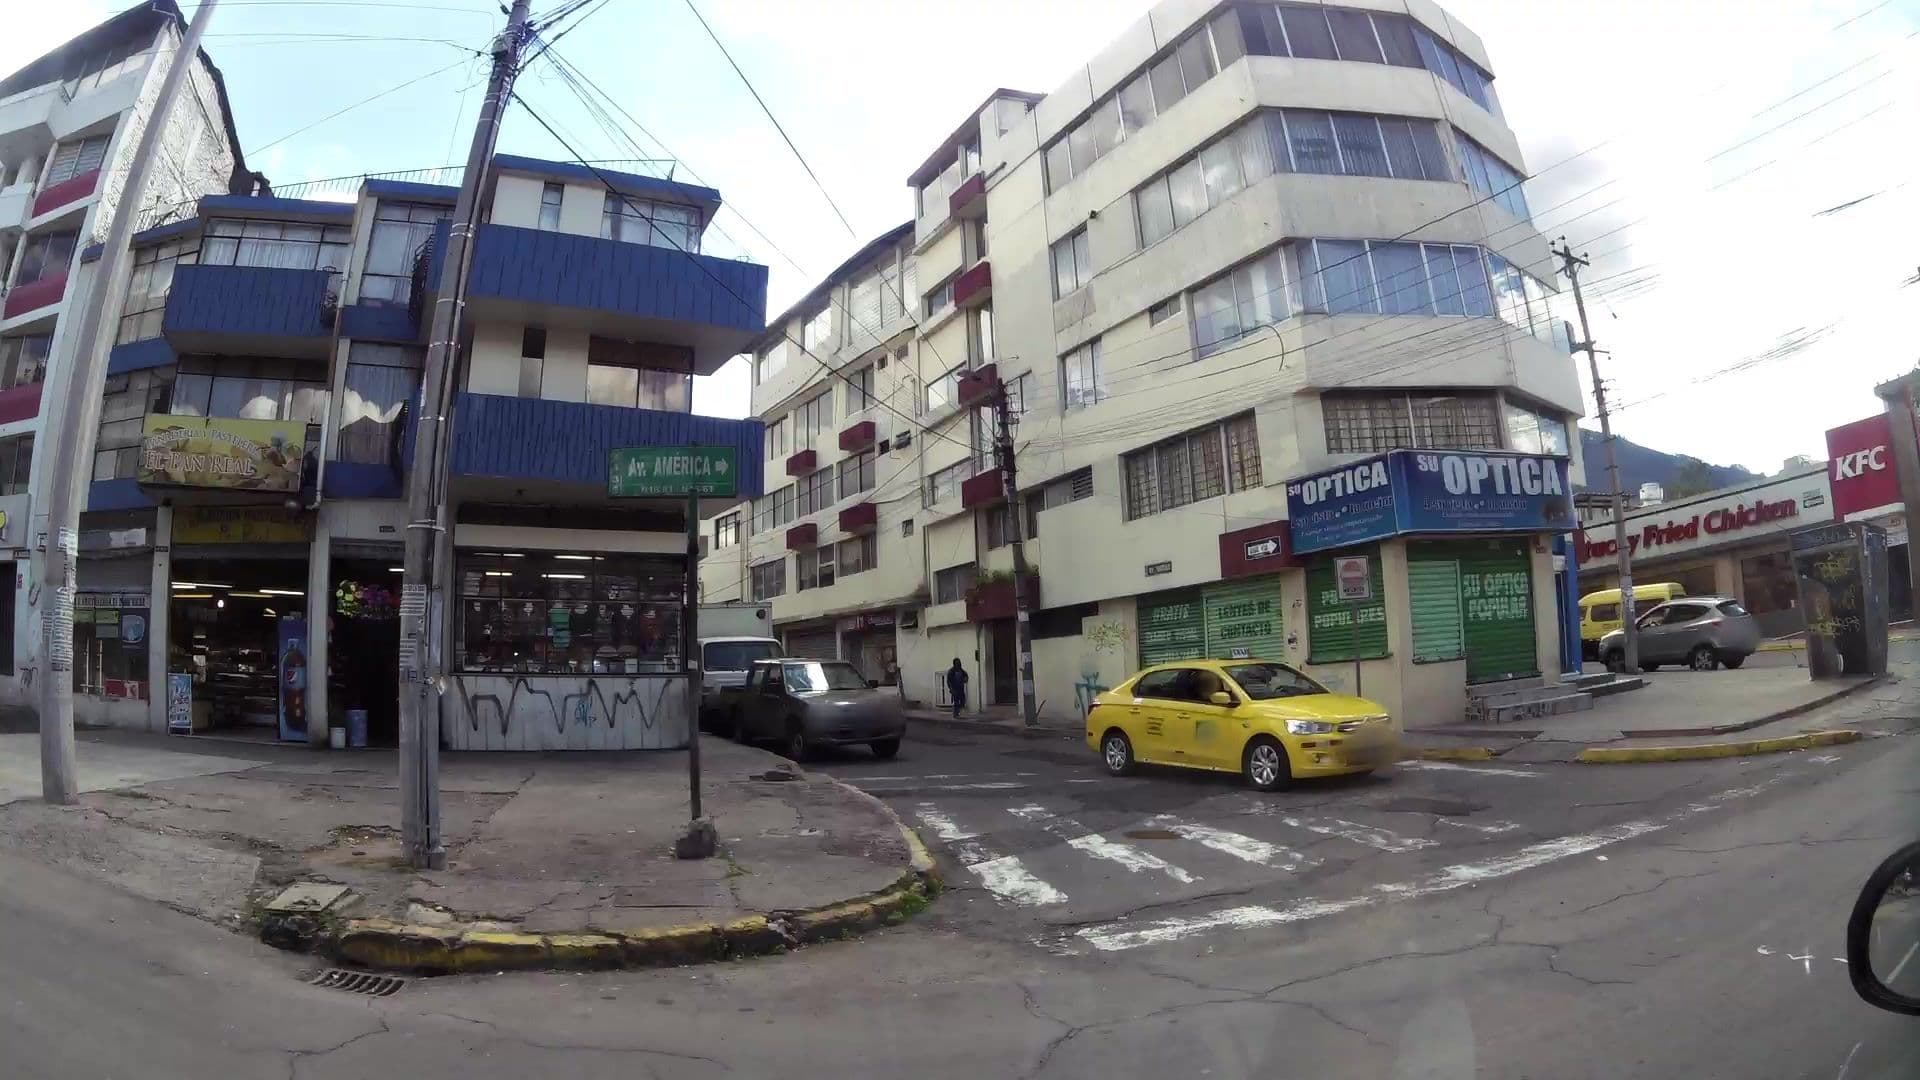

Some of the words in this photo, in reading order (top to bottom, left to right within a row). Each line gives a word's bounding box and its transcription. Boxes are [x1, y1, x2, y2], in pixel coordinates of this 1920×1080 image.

[168, 451, 206, 472] PAN
[209, 453, 257, 475] REAL
[1417, 454, 1439, 472] SU
[1441, 455, 1563, 496] OPTICA
[1834, 445, 1887, 481] KFC
[1288, 484, 1301, 497] SU
[1302, 461, 1388, 505] OPTICA
[1643, 516, 1699, 549] Fried
[1704, 498, 1797, 535] Chicken
[1463, 574, 1481, 597] SU
[1257, 599, 1271, 613] DE
[1220, 619, 1272, 639] CONTACTO
